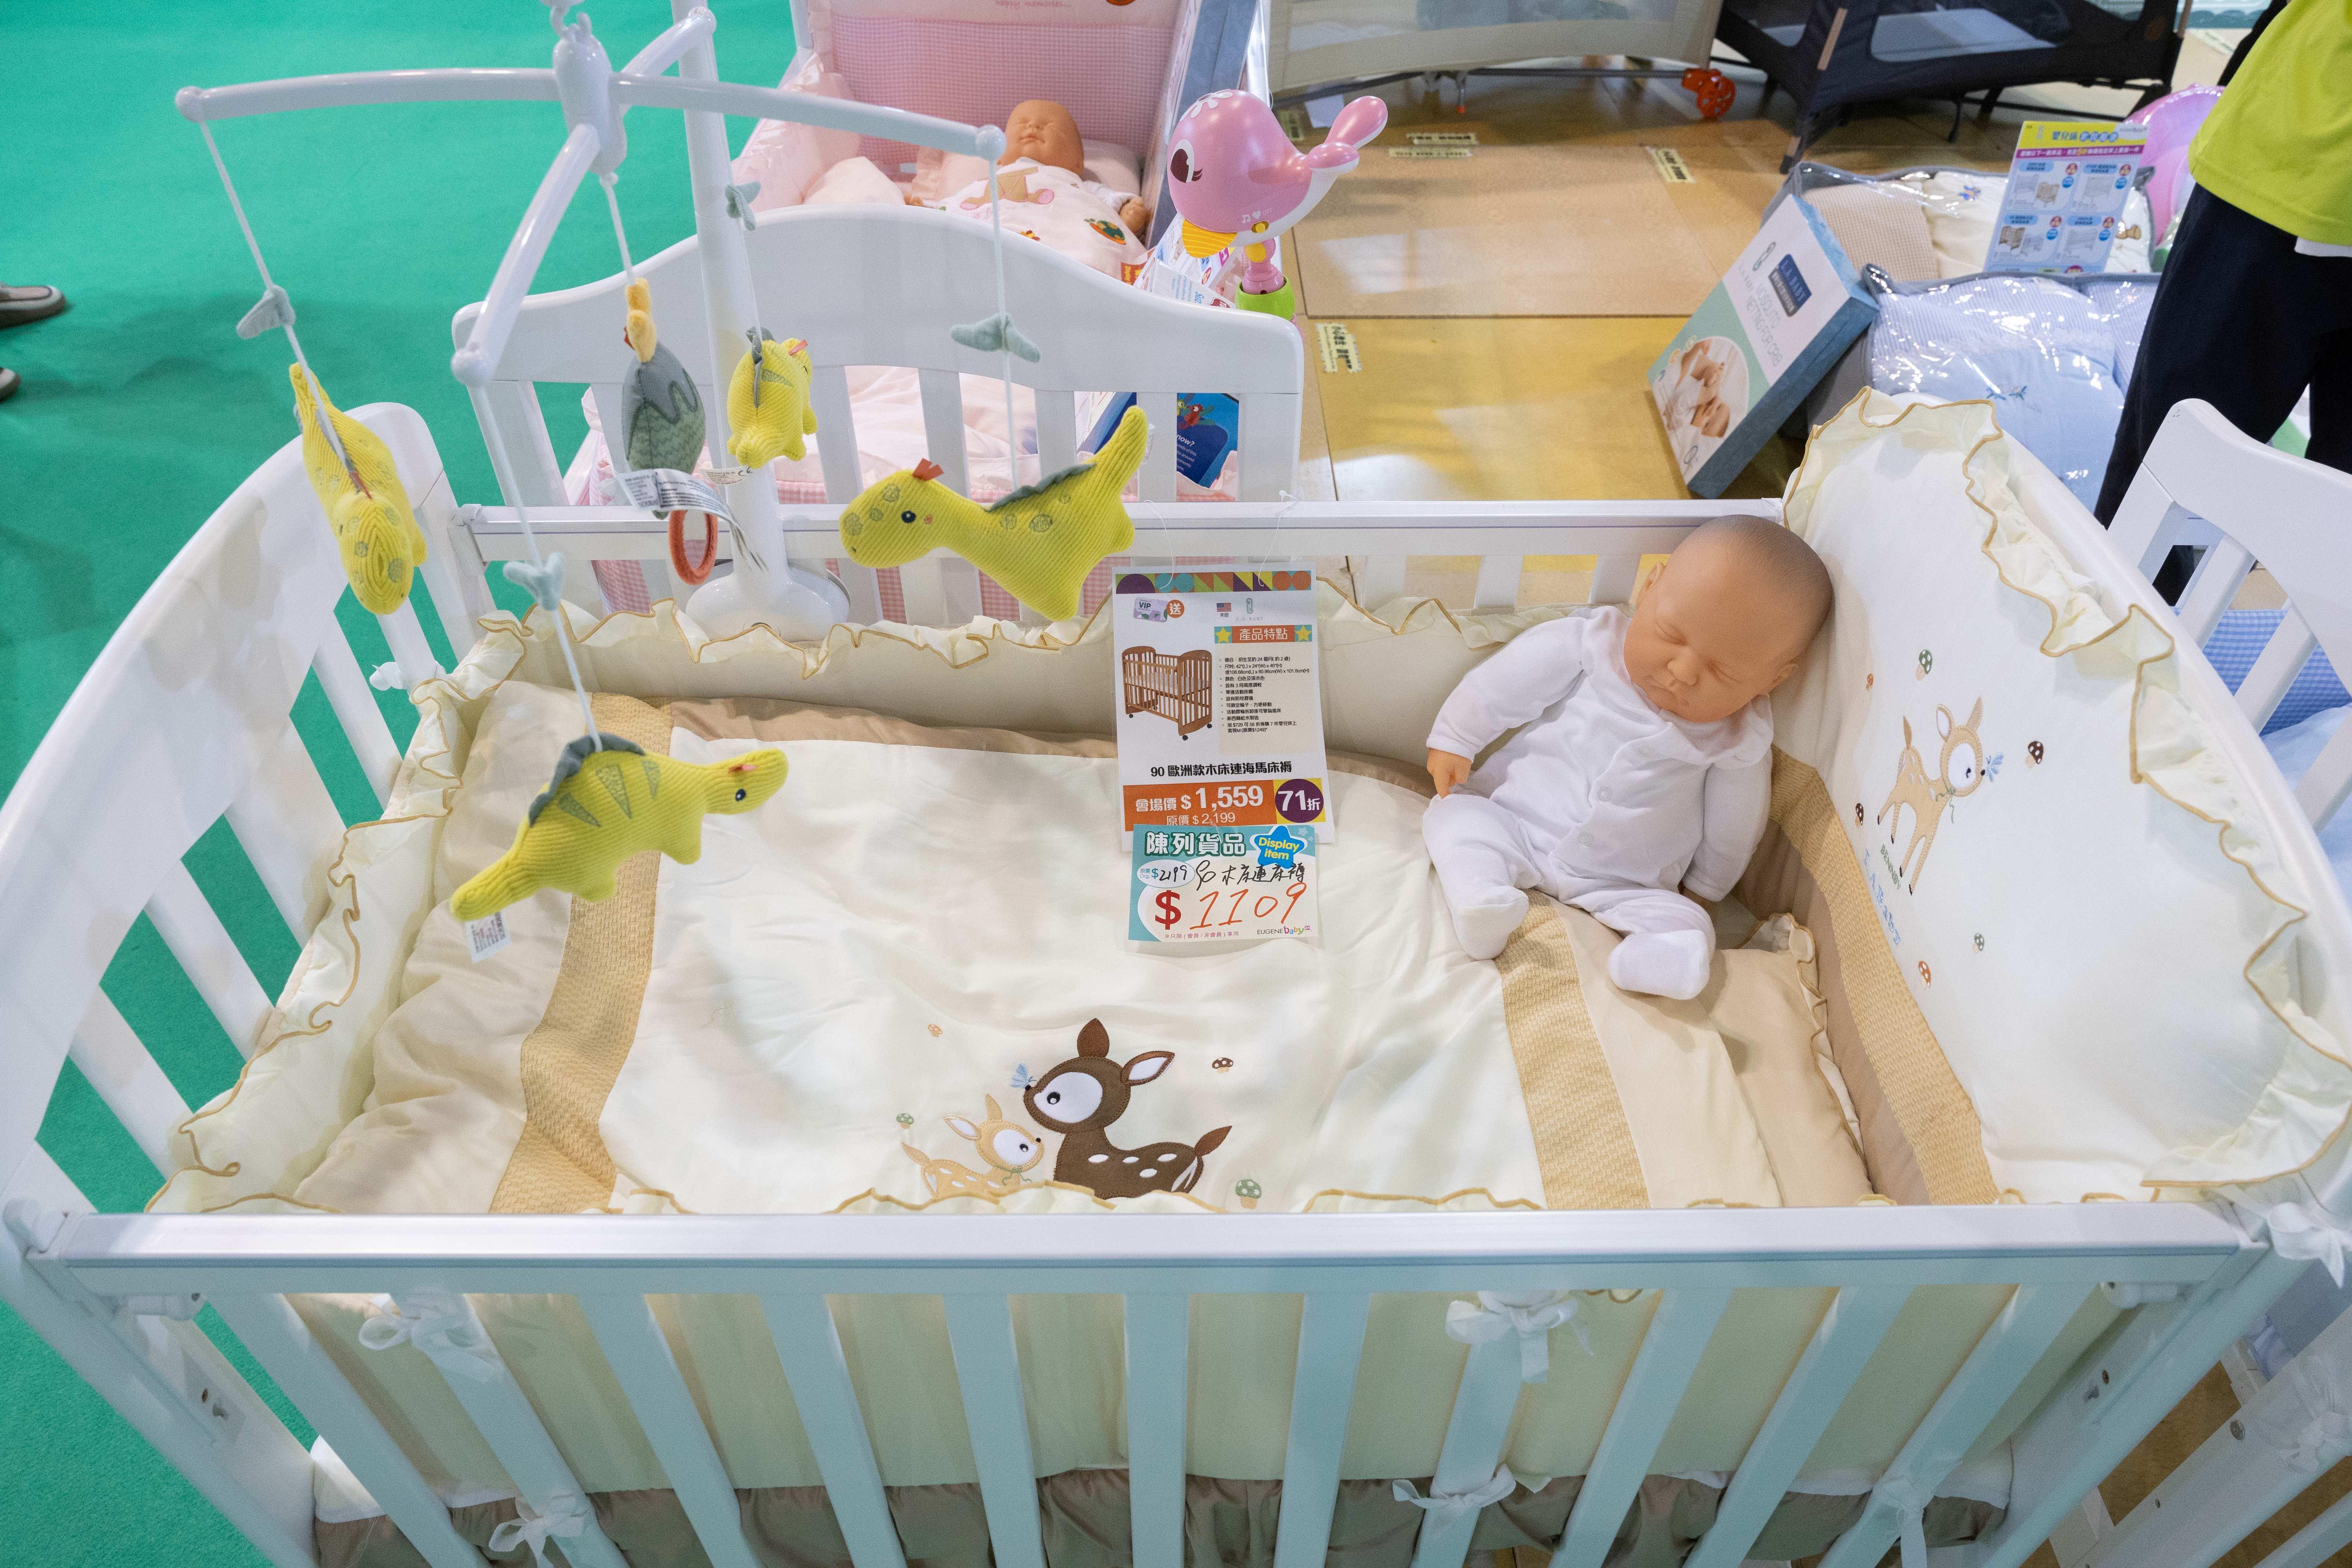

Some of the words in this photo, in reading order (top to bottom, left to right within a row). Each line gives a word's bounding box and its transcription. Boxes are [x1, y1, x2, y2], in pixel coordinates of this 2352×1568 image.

[1177, 434, 1195, 446] now?
[1169, 602, 1181, 615] 送
[1240, 628, 1288, 641] 產品特點
[1151, 767, 1165, 777] 90
[1168, 761, 1292, 777] 歐洲款木床連海馬床褥
[1135, 798, 1177, 812] 會場價
[1167, 815, 1189, 826] 原價
[1145, 831, 1245, 856] 陳列貨品
[1258, 837, 1300, 853] Display
[1264, 848, 1289, 860] item
